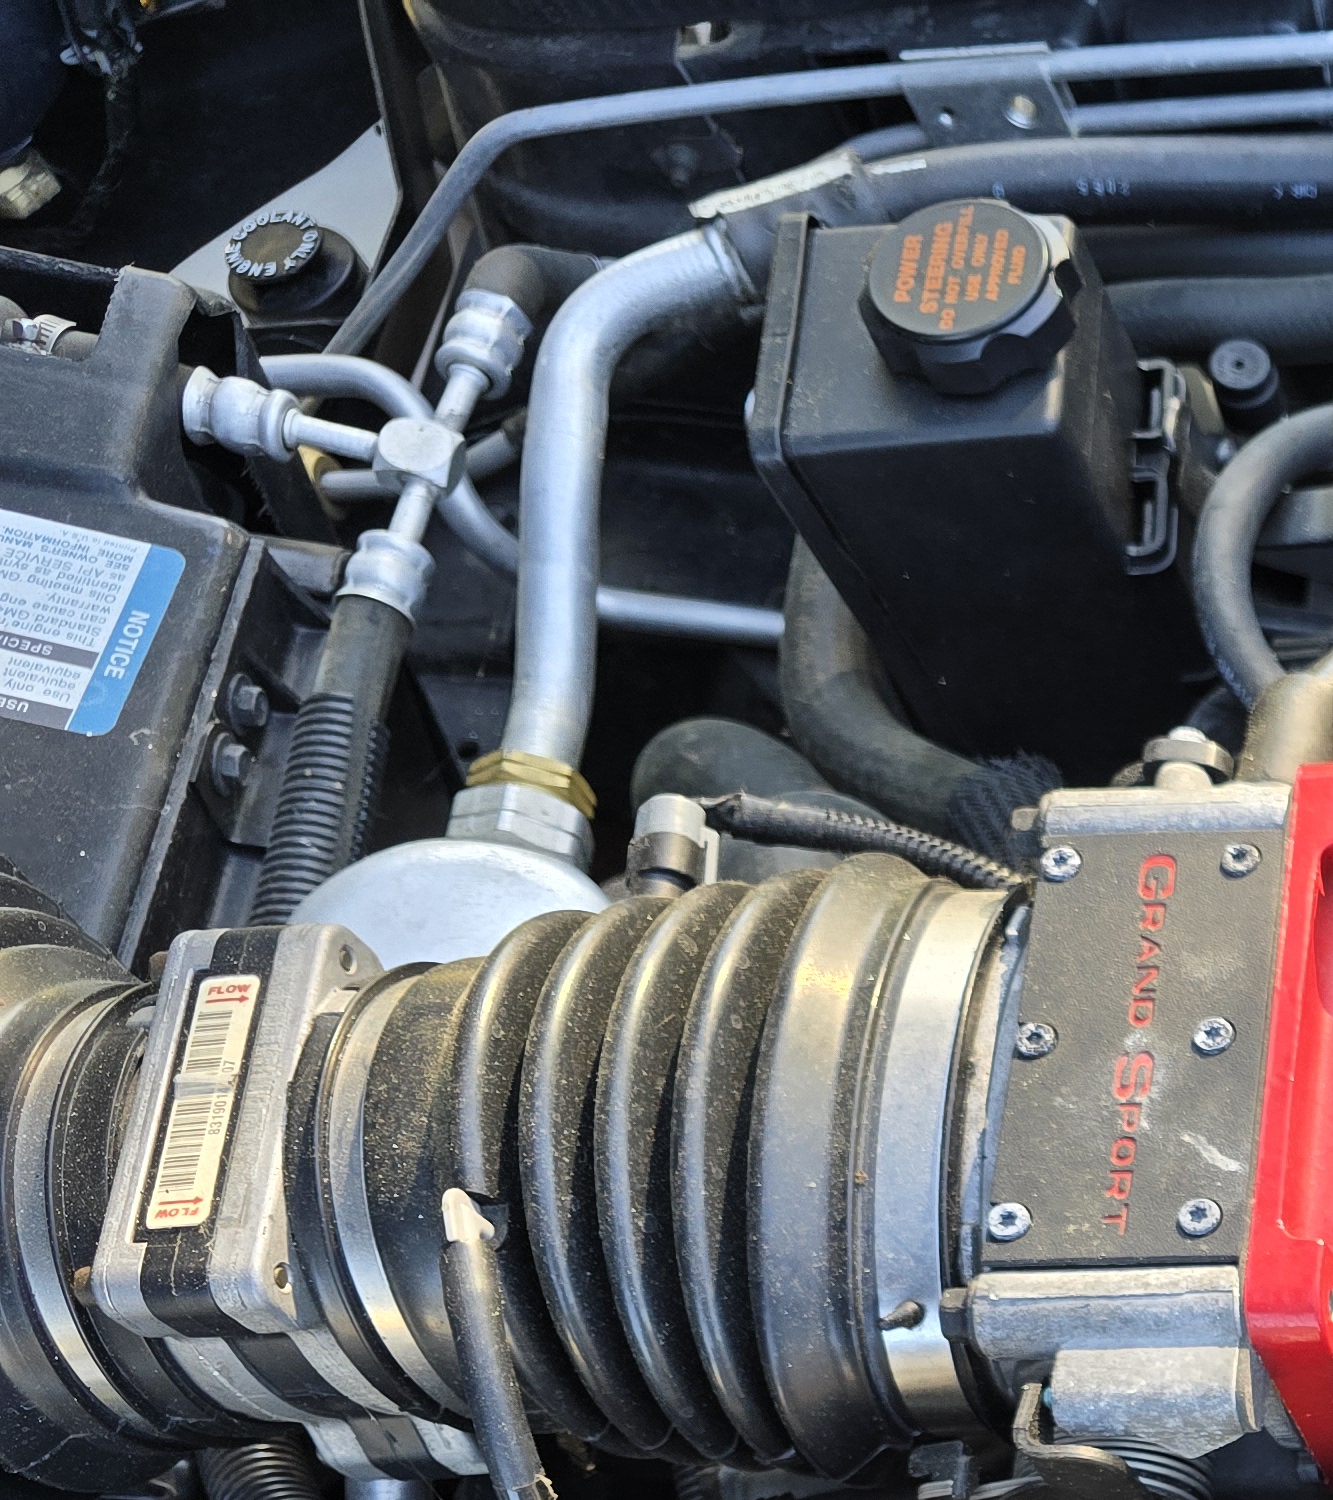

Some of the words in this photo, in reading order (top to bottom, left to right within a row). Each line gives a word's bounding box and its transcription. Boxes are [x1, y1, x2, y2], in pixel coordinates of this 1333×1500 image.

[232, 210, 317, 241] COOLANT
[951, 204, 975, 270] OVERFILL
[224, 241, 277, 278] ENGINE
[283, 230, 319, 271] ONLY
[971, 233, 989, 268] ONLY
[893, 234, 923, 303] POWER
[919, 221, 954, 314] STEERING
[985, 228, 1009, 301] APPROVED
[1007, 244, 1027, 285] FLUID
[945, 276, 961, 304] NOT
[965, 273, 982, 302] USE
[938, 308, 956, 331] DO
[3, 547, 74, 572] SERVICE
[39, 544, 99, 565] OWNER'S
[98, 548, 134, 564] MORE
[104, 559, 131, 572] SEE
[34, 564, 52, 576] as
[78, 564, 105, 579] API
[109, 571, 127, 582] as
[27, 574, 84, 595] meeting
[55, 571, 122, 594] identified
[46, 591, 111, 615] warranty.
[88, 588, 117, 604] Oils
[32, 601, 76, 618] cause
[79, 612, 107, 625] can
[11, 619, 61, 638] engine
[34, 613, 102, 638] Standard
[66, 631, 95, 648] This
[103, 609, 151, 680] NOTICE
[3, 667, 76, 691] equivalent
[7, 656, 82, 680] equivalent
[4, 677, 35, 693] only
[43, 688, 71, 703] Use
[1127, 853, 1178, 1029] GRAND
[207, 983, 252, 996] FLOW
[1100, 1051, 1156, 1236] SPORT
[154, 1206, 200, 1219] FLOW
